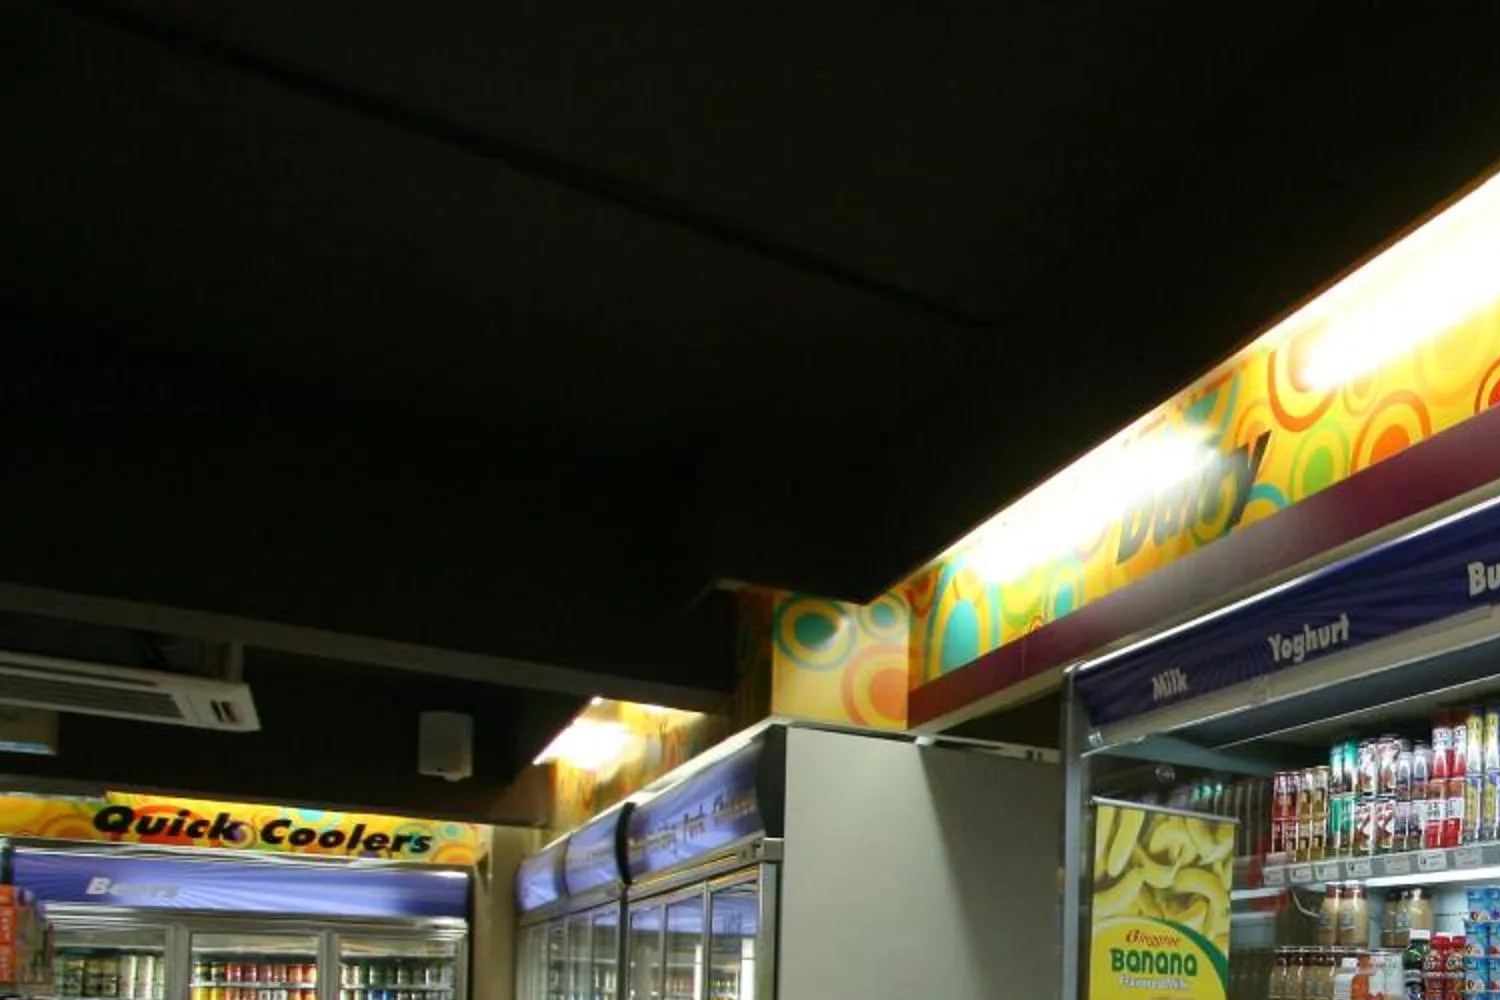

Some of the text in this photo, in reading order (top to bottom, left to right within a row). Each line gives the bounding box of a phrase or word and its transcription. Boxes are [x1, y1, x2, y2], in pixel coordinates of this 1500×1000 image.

[1267, 613, 1350, 663] Yoghurt
[1152, 667, 1189, 701] Milk
[93, 805, 433, 854] Quick Coolers
